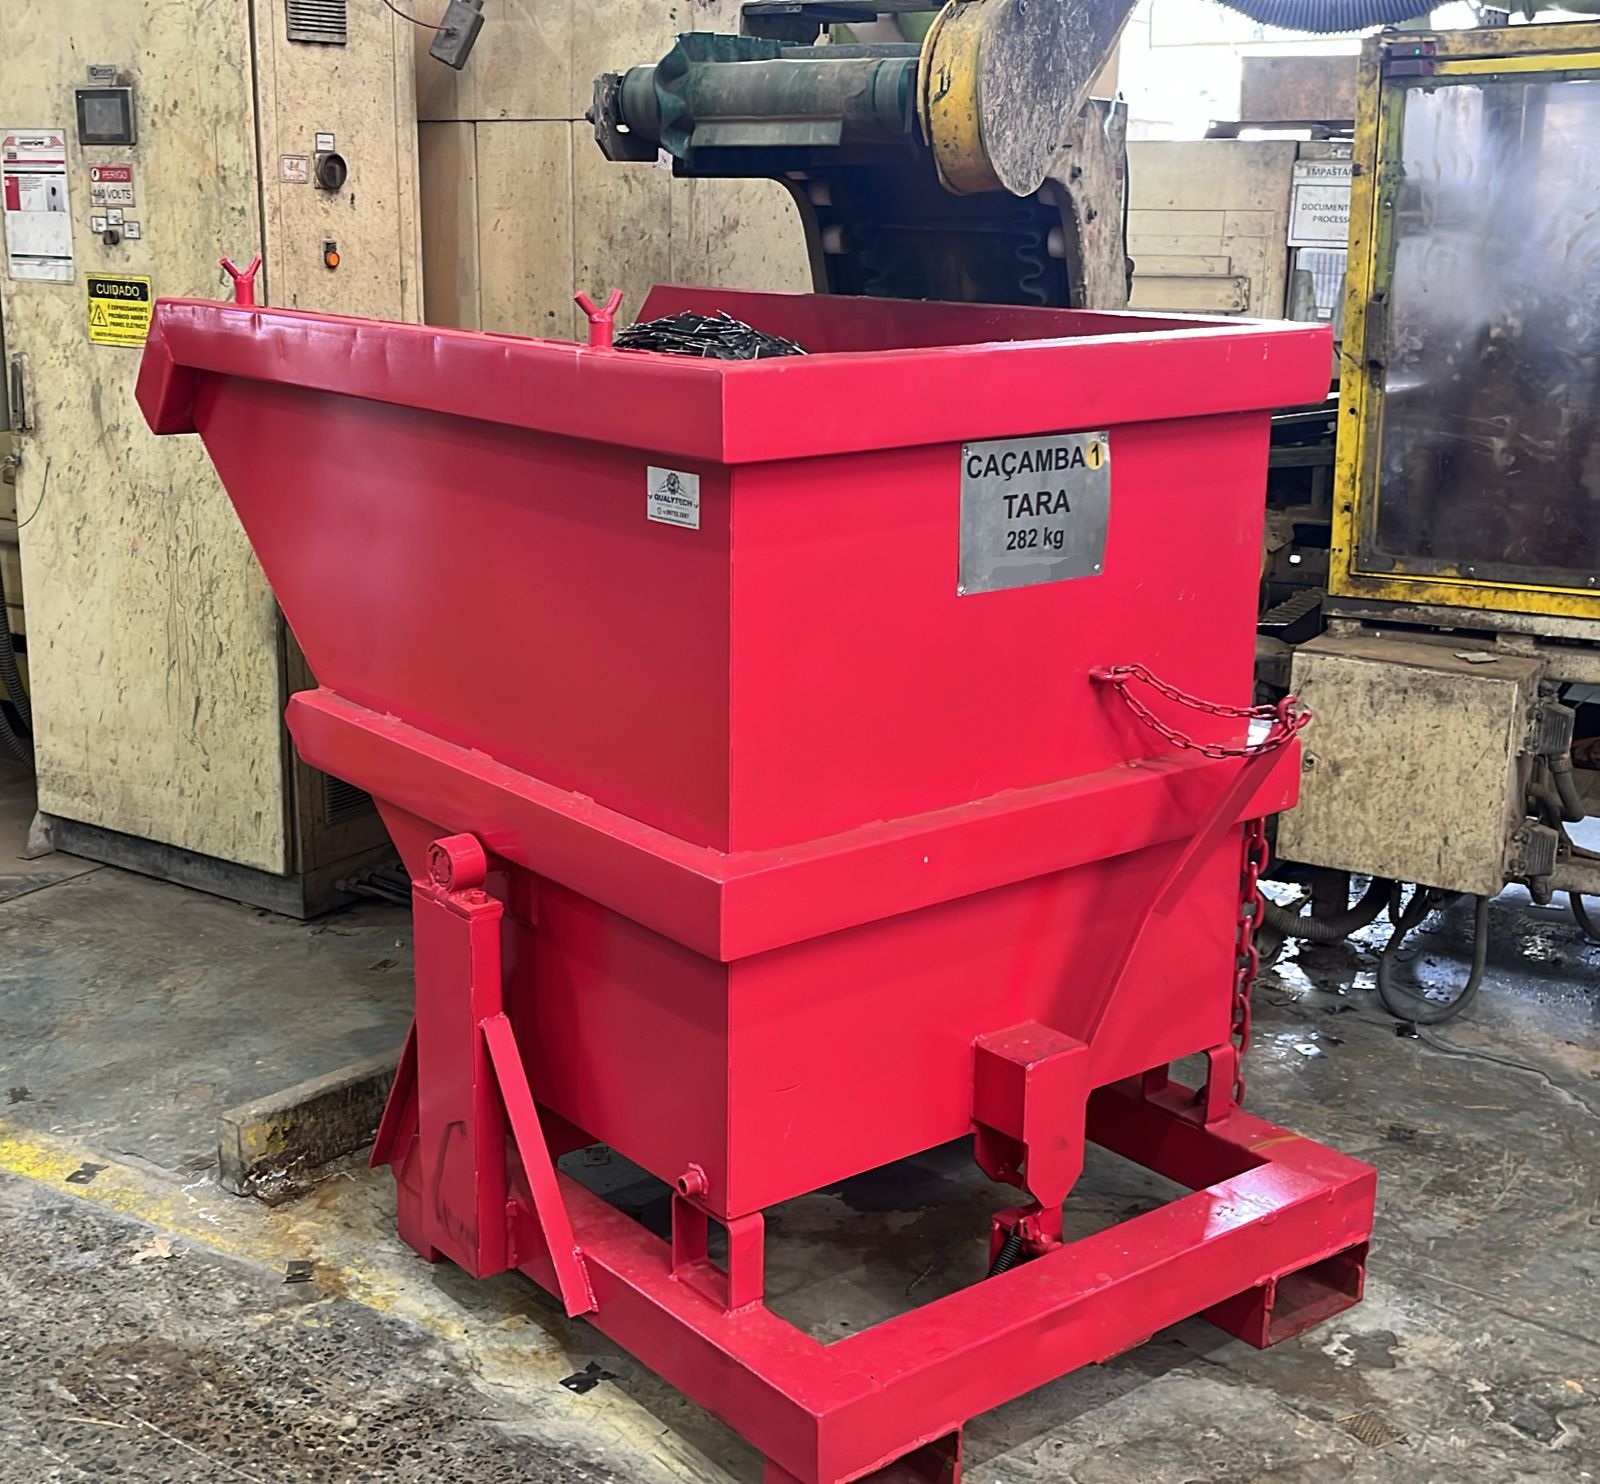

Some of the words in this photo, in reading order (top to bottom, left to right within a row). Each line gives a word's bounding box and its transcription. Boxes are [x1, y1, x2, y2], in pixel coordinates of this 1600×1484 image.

[101, 170, 128, 179] PERIGO
[106, 188, 132, 200] VOLTS
[1301, 203, 1349, 212] DOCUMENT
[95, 283, 140, 297] CUIDADO
[966, 446, 1086, 481] CAÇAMBA
[1091, 443, 1100, 466] 1
[653, 493, 693, 508] QUALYTECH
[1003, 489, 1071, 519] TARA
[1006, 528, 1038, 551] 282
[1043, 527, 1064, 549] kg
